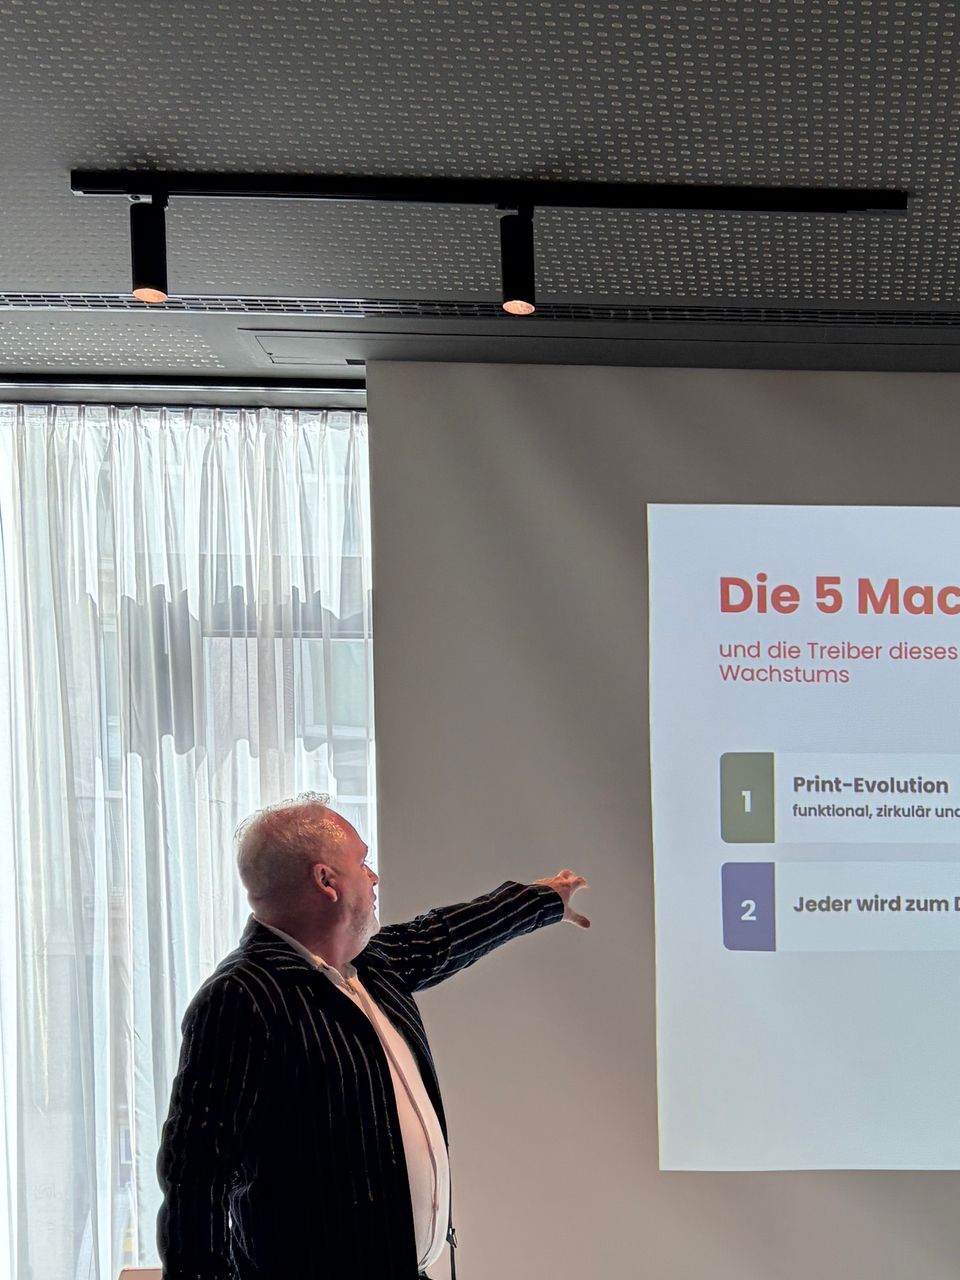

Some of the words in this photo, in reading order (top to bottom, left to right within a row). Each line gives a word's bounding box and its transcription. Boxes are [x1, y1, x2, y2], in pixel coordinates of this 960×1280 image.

[719, 572, 801, 615] Die
[815, 575, 844, 614] 5
[719, 640, 761, 659] und
[767, 640, 801, 660] die
[806, 641, 883, 660] Treiber
[888, 641, 959, 661] dieses
[718, 664, 850, 684] Wachstums
[793, 774, 949, 794] Print-Evolution
[741, 790, 752, 813] 1
[792, 803, 873, 820] funktional,
[875, 804, 932, 818] zirkulär
[740, 899, 757, 921] 2
[792, 895, 853, 913] Jeder
[855, 893, 902, 912] wird
[904, 898, 950, 912] zum
